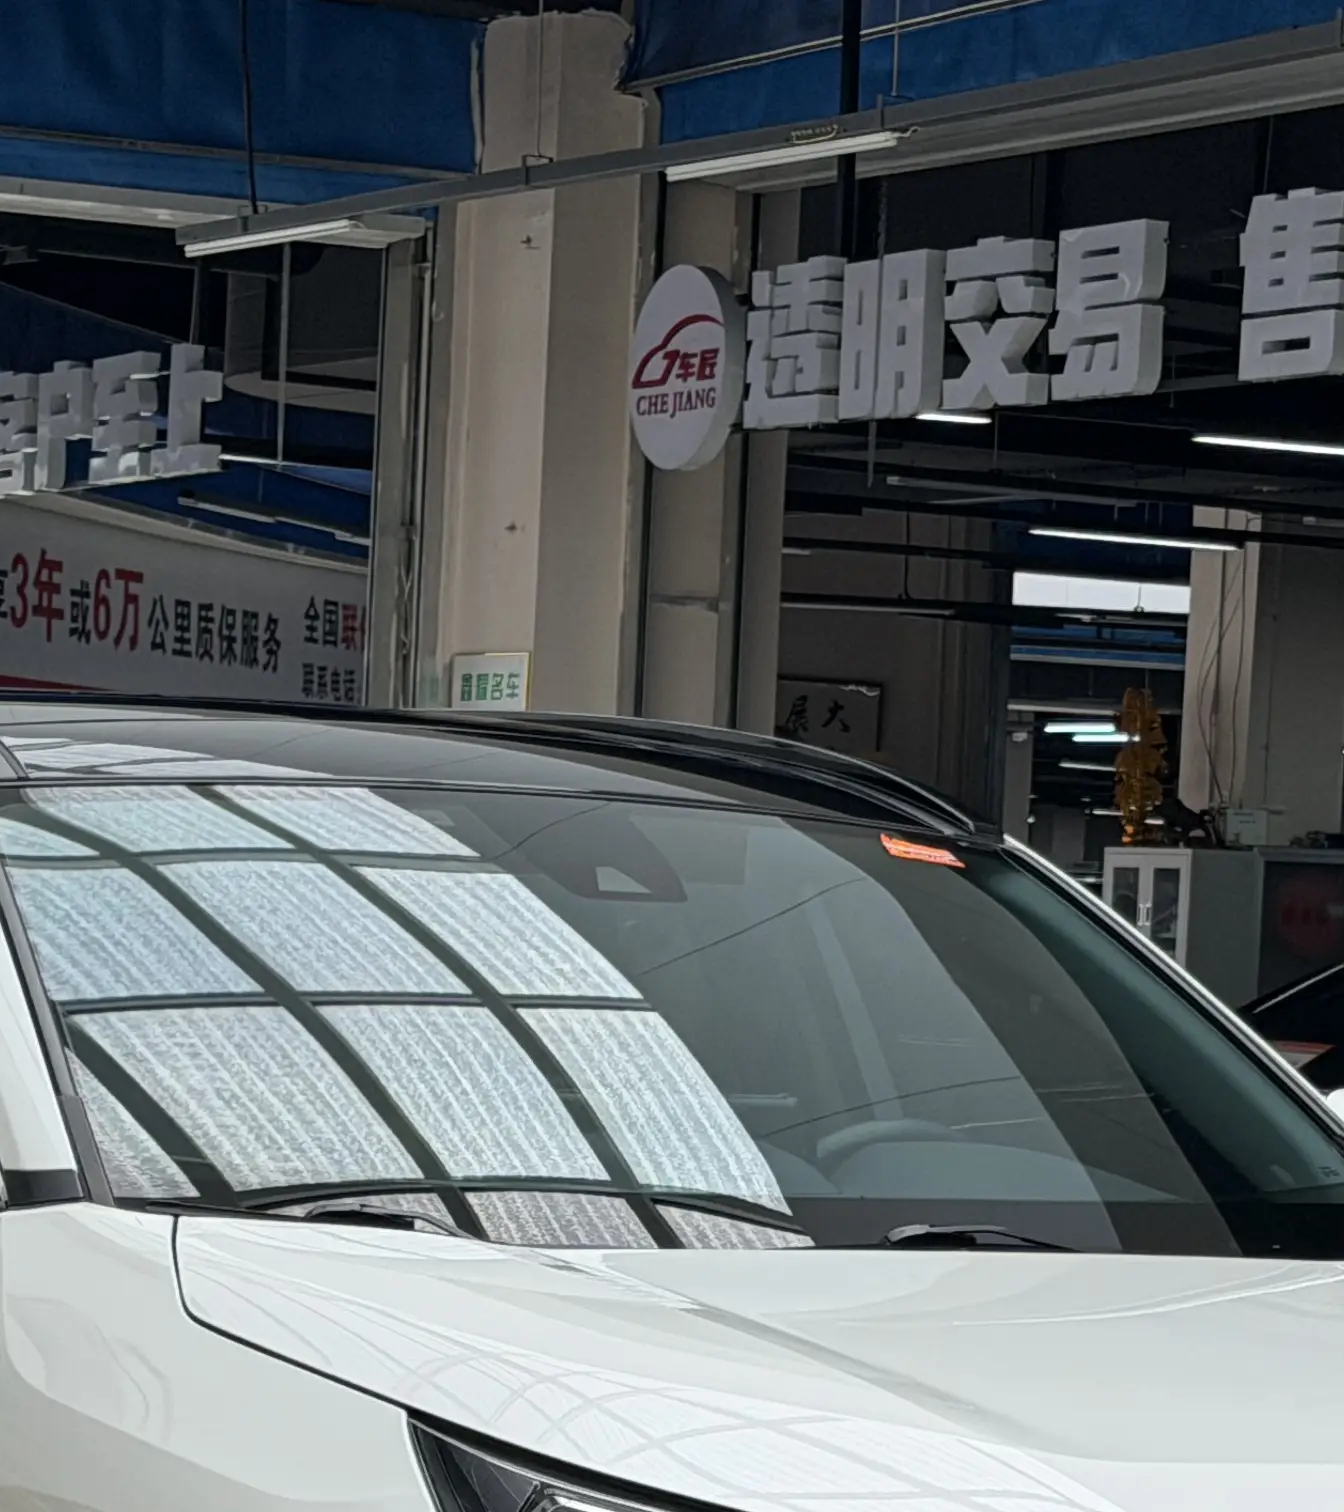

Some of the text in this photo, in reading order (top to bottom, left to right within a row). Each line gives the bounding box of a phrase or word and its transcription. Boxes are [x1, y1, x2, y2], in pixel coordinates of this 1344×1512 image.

[743, 218, 1169, 429] 透明交易
[636, 387, 716, 419] CHE JIANG
